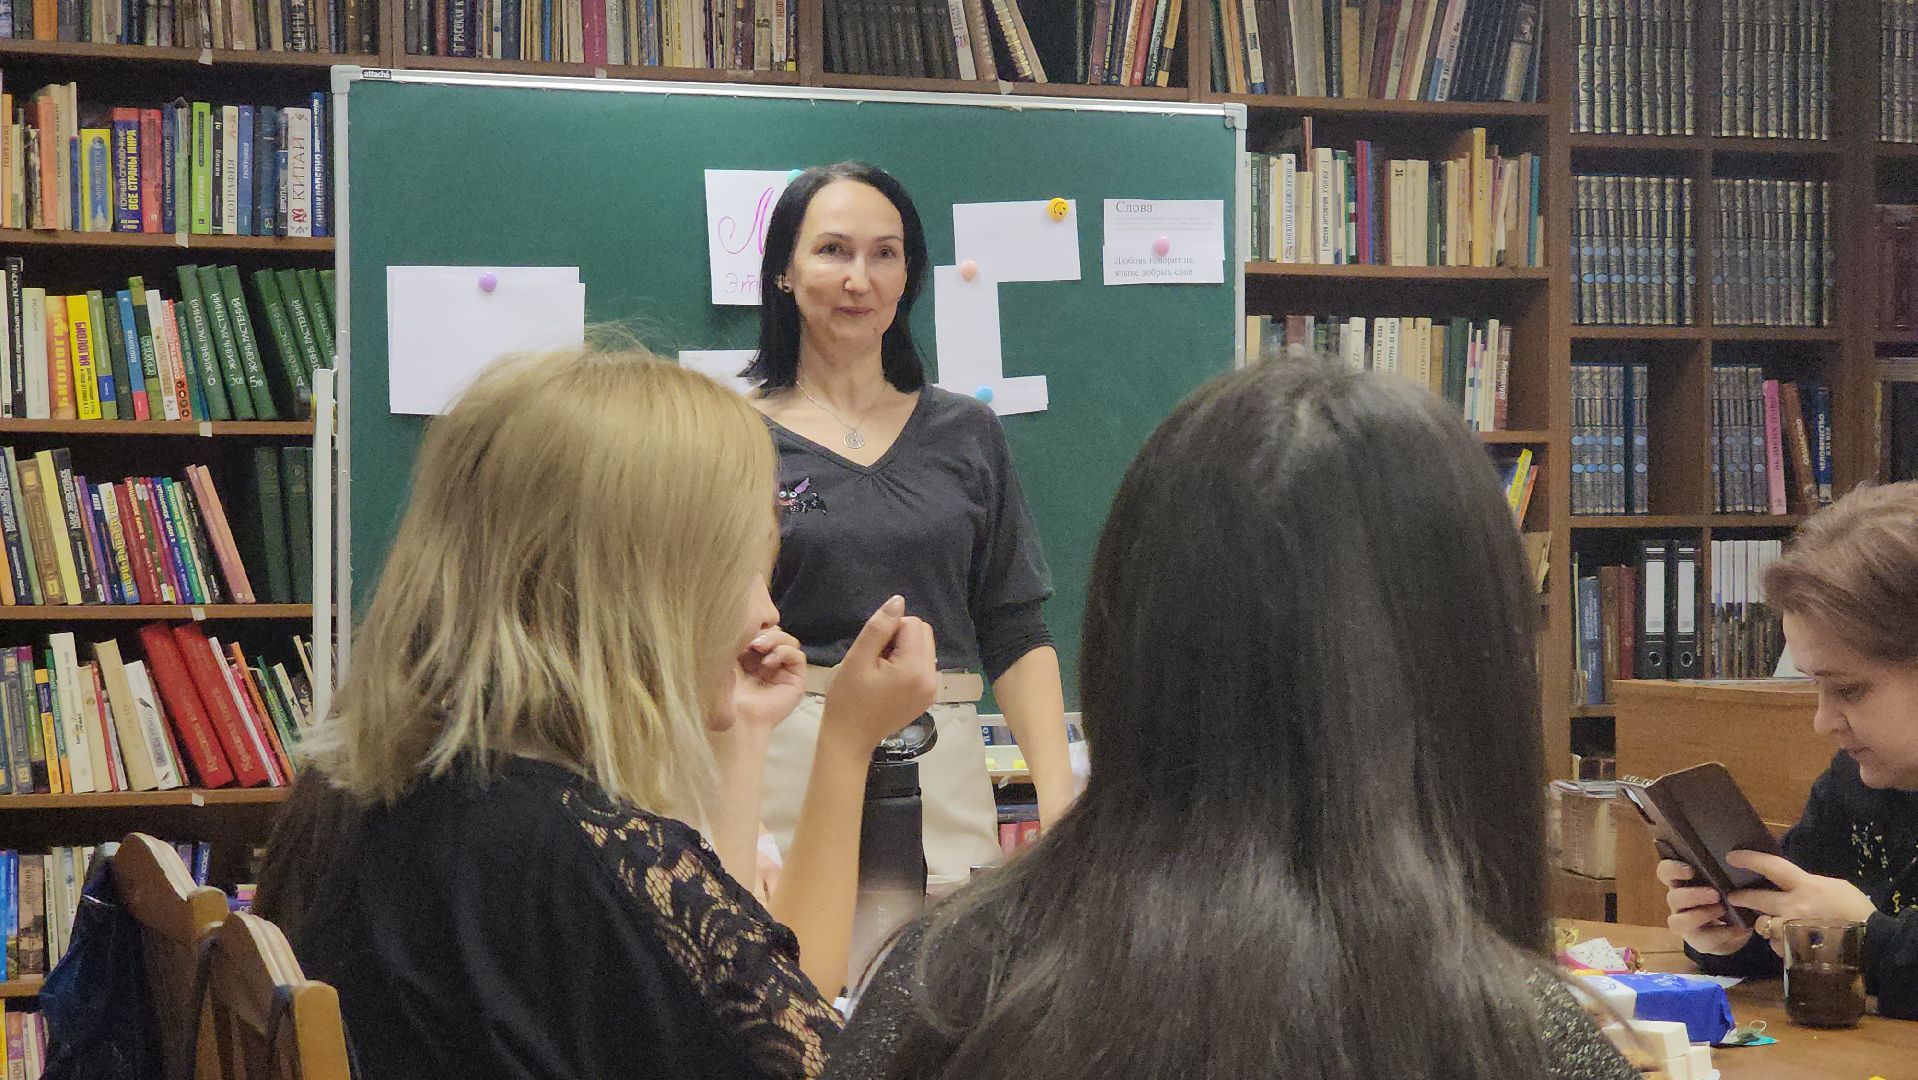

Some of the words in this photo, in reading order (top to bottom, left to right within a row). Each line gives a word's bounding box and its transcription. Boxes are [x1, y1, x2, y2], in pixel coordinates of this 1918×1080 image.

[453, 9, 465, 41] РУССКАЯ
[363, 70, 390, 78] attaché
[118, 128, 126, 176] СПРАВОЧНИК
[127, 129, 136, 153] МИРА
[127, 156, 137, 190] СТРАНЫ
[290, 136, 304, 200] КИТАЙ
[127, 193, 138, 209] ВСЕ
[1116, 201, 1153, 213] Слова
[1114, 257, 1147, 265] Любовь
[188, 297, 206, 343] РАСТЕНИЙ
[209, 291, 230, 339] РАСТЕНИЙ
[231, 296, 250, 343] РАСТЕНИЙ
[269, 301, 290, 346] РАСТЕНИЙ
[290, 297, 313, 345] РАСТЕНИЙ
[53, 311, 68, 407] БИОЛОГИЯ
[75, 321, 89, 366] БИОЛОГИЯ
[141, 336, 155, 373] ГРИБЫ
[199, 342, 213, 374] ЖИЗНЬ
[222, 339, 237, 370] ЖИЗНЬ
[243, 341, 258, 373] ЖИЗНЬ
[285, 345, 300, 375] ЖИЗНЬ
[207, 374, 216, 386] 6
[1497, 359, 1509, 400] Литература
[1817, 413, 1826, 470] ЧЕЛОВЕЧЕСТВО
[59, 468, 74, 512] ЖИВОТНЫХ
[126, 479, 140, 515] ЖИВОТНЫХ
[155, 483, 170, 519] ЖИВОТНЫХ
[165, 484, 181, 519] ЖИВОТНЫХ
[67, 511, 78, 529] МИР
[165, 520, 175, 537] МИРЕ
[175, 520, 186, 538] МИРЕ
